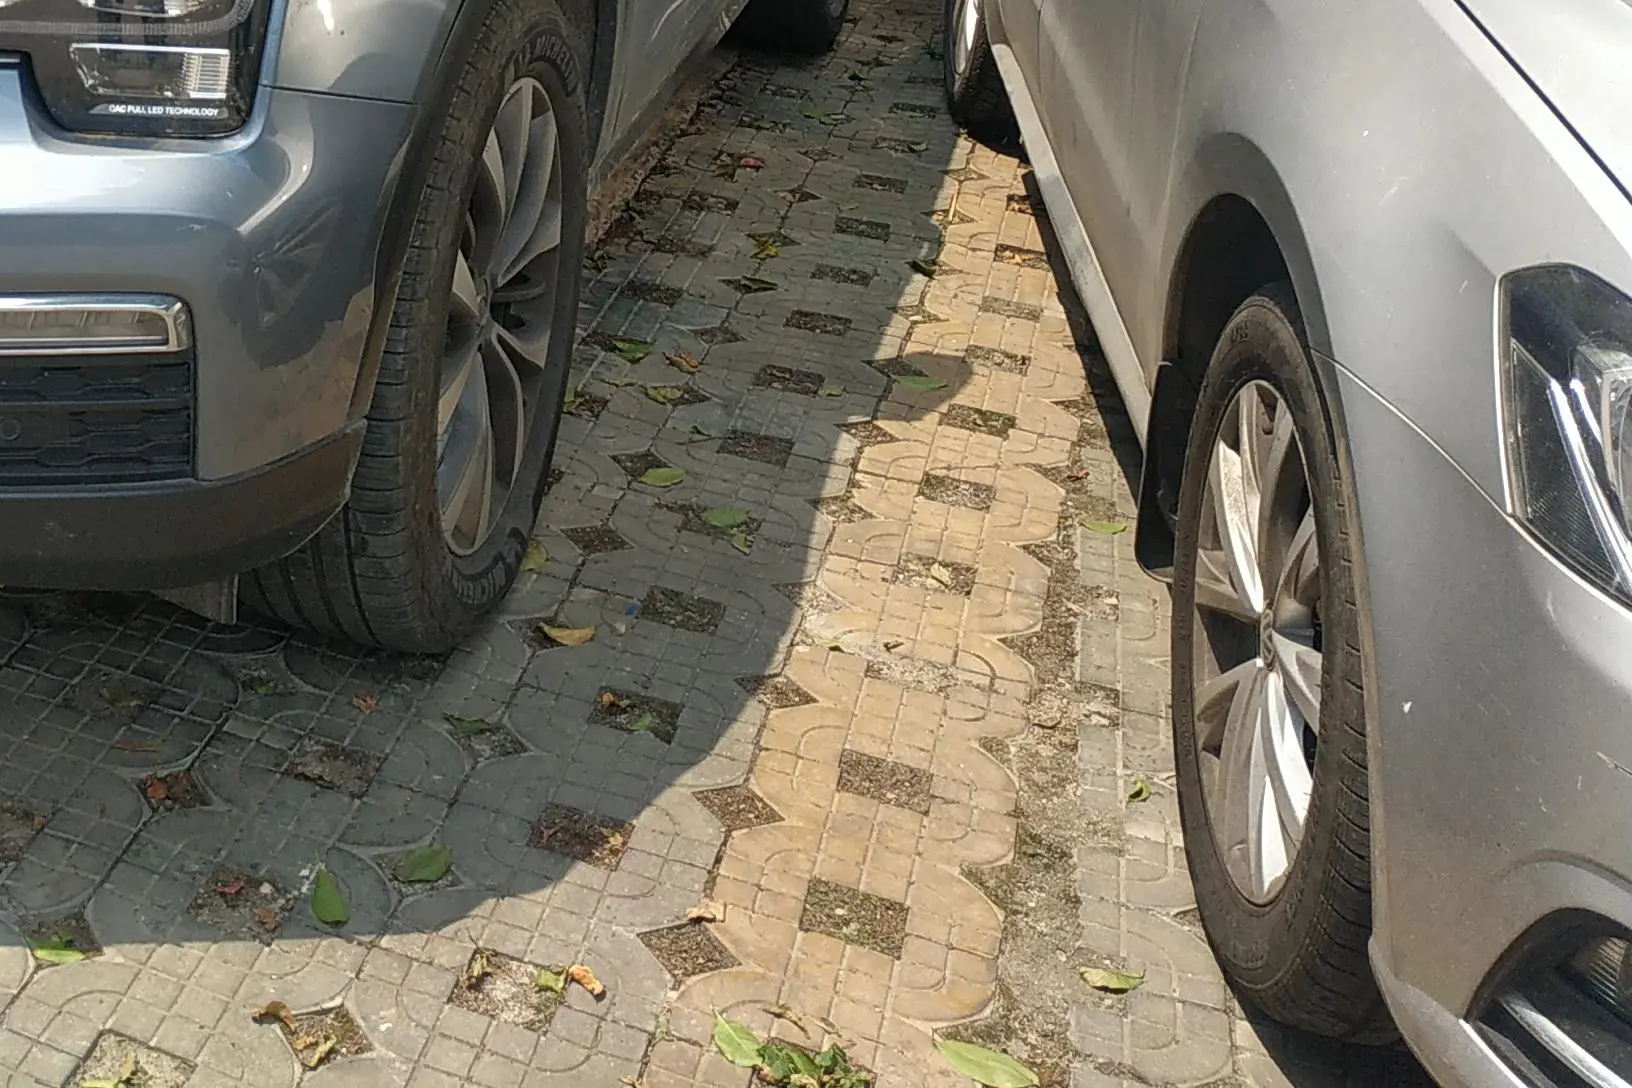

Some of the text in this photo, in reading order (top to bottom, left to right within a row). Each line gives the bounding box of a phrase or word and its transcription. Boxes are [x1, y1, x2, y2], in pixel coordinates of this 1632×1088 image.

[127, 105, 146, 114] FULL
[147, 105, 164, 114] LED
[165, 106, 218, 117] TECHNOLOGY
